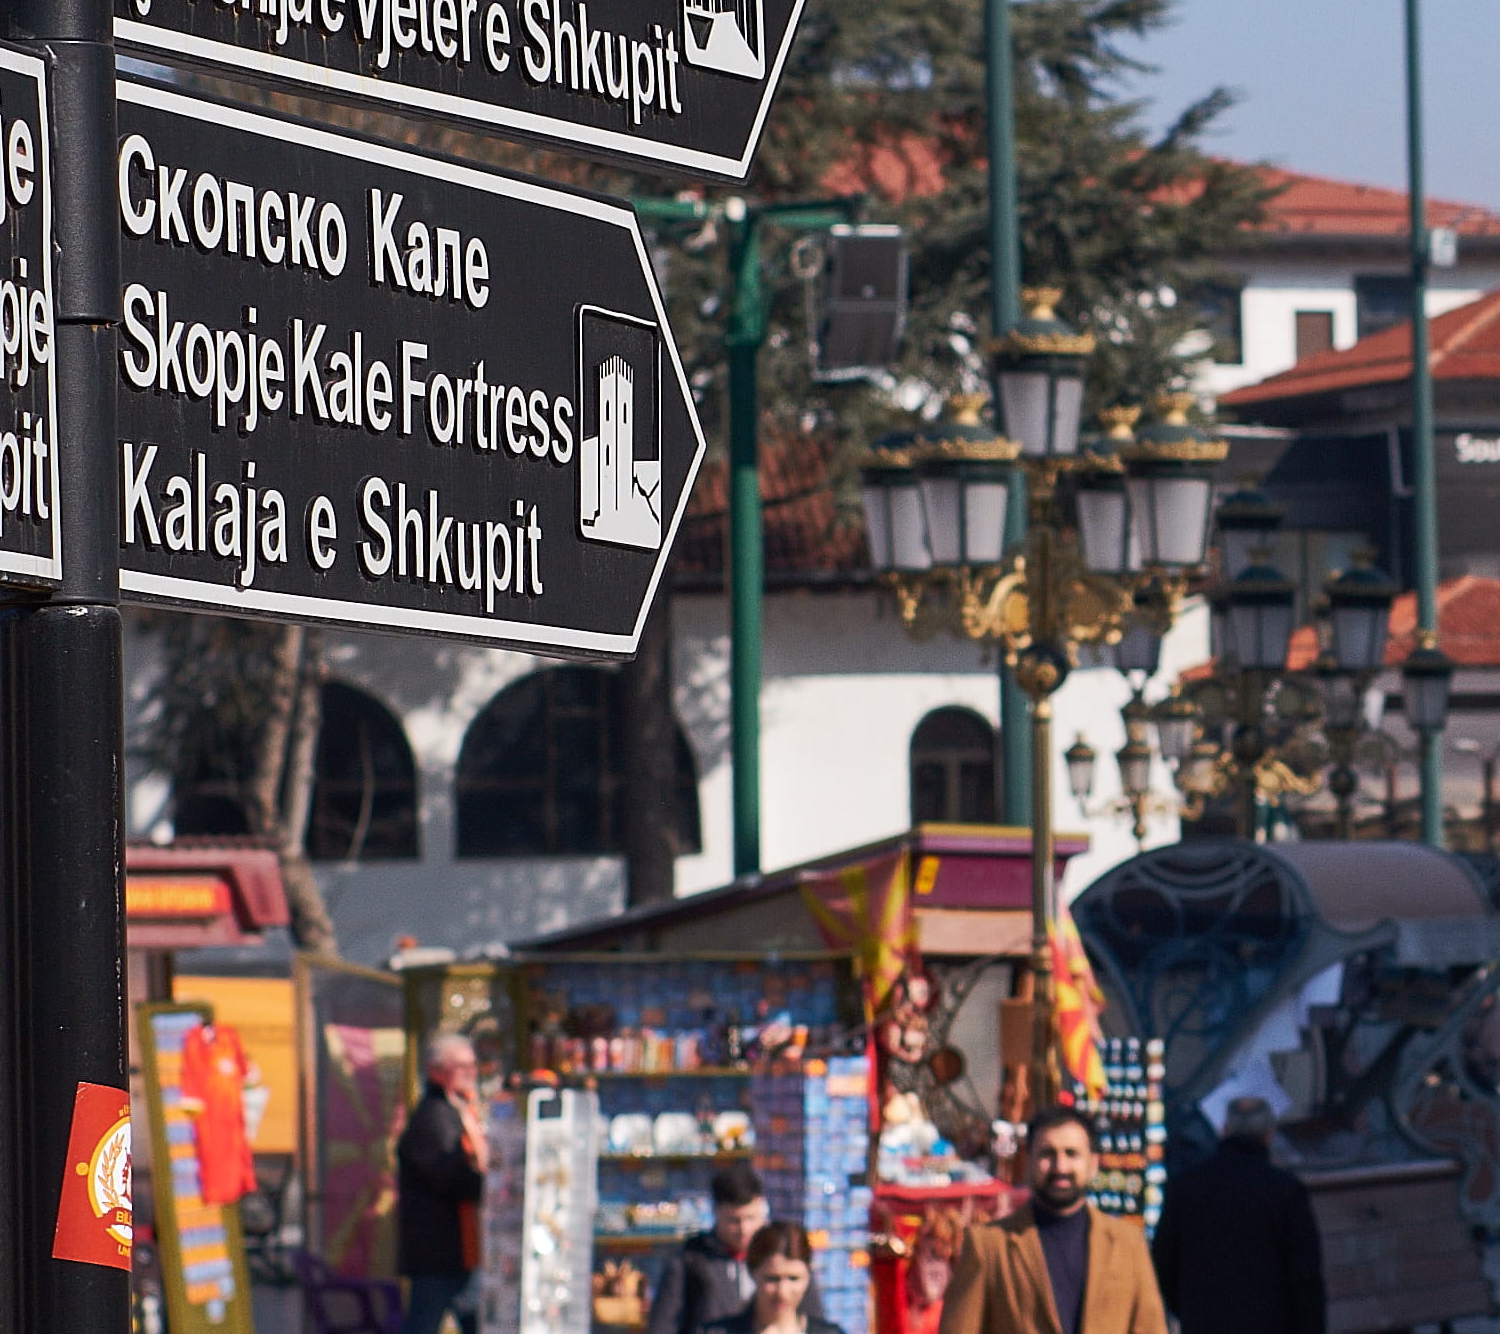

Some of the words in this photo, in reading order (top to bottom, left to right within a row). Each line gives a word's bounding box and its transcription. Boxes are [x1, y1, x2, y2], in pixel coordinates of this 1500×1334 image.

[486, 1, 511, 73] e
[119, 134, 347, 276] Скопско
[372, 189, 490, 307] Кале
[122, 283, 284, 432] Skopje
[293, 318, 393, 432] Kale
[402, 341, 573, 464] Fortress
[124, 442, 288, 588] Kalaja
[310, 495, 336, 569] e
[362, 477, 543, 612] Shkupit
